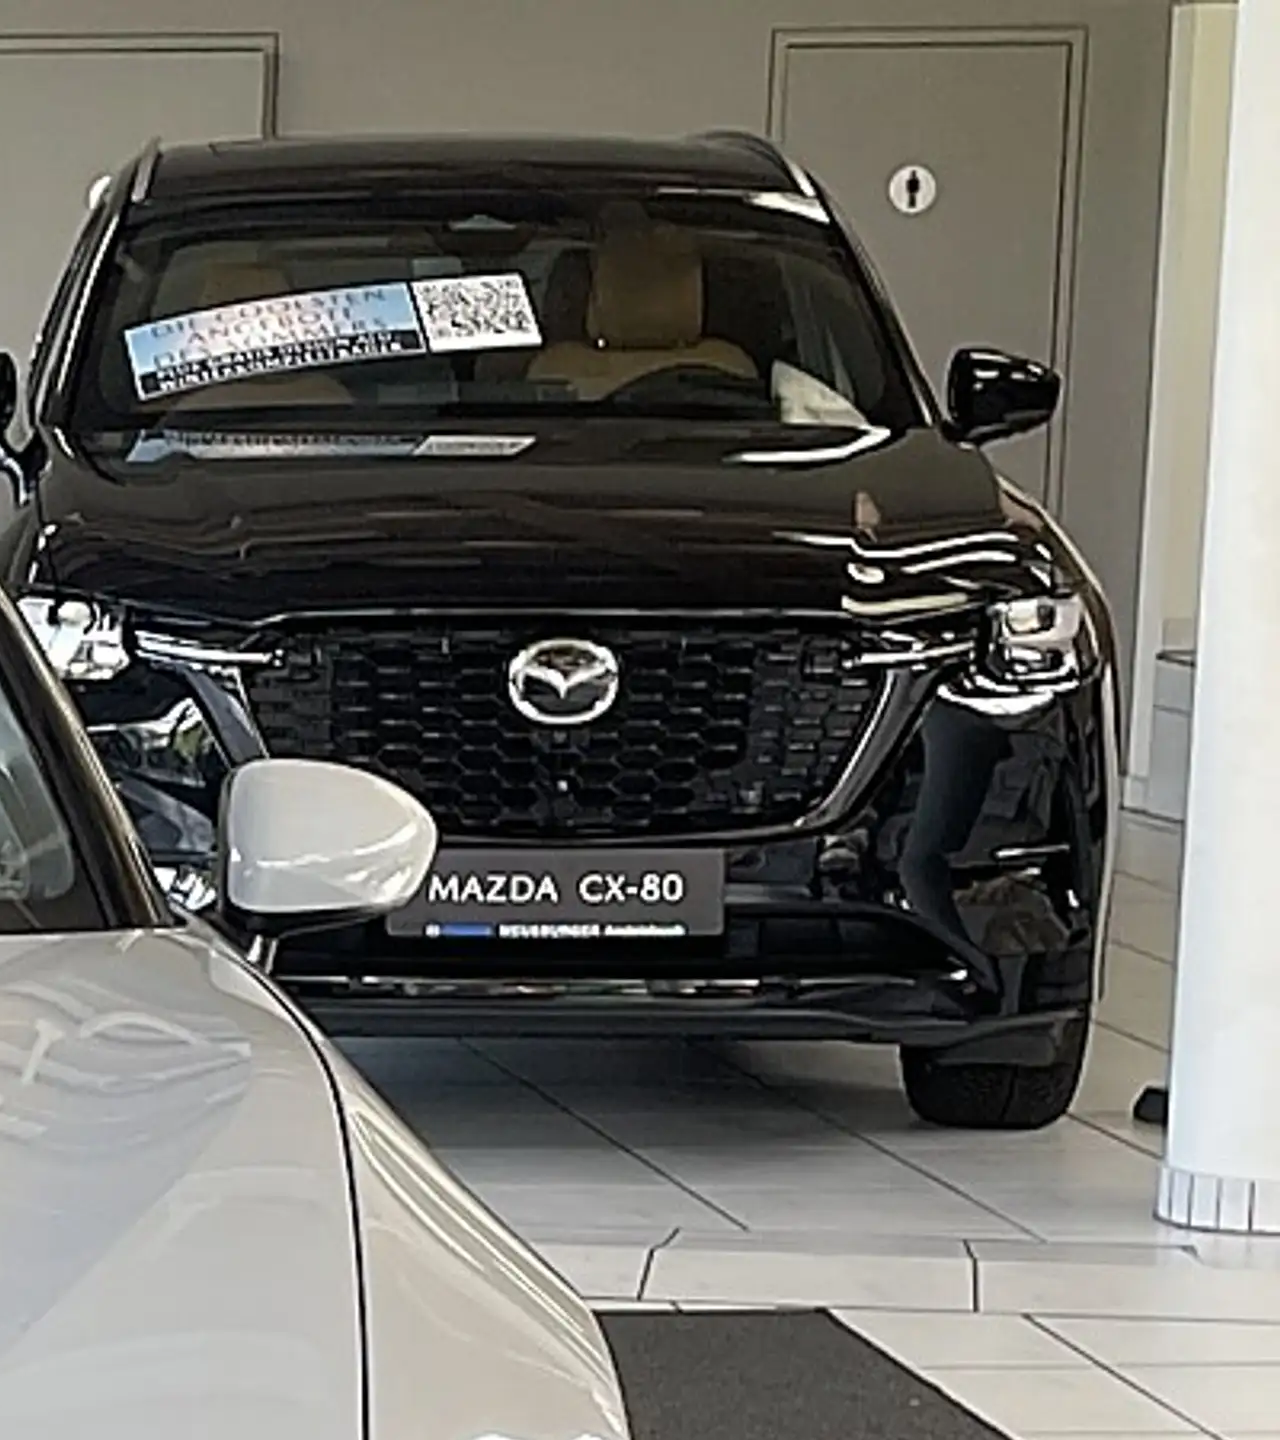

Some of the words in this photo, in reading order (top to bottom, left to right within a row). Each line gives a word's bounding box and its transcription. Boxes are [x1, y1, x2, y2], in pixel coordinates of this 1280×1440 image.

[214, 288, 387, 323] COOLSTEN
[187, 306, 353, 345] ANGEBOTE
[428, 874, 559, 902] MAZDA
[578, 873, 684, 902] CX-80
